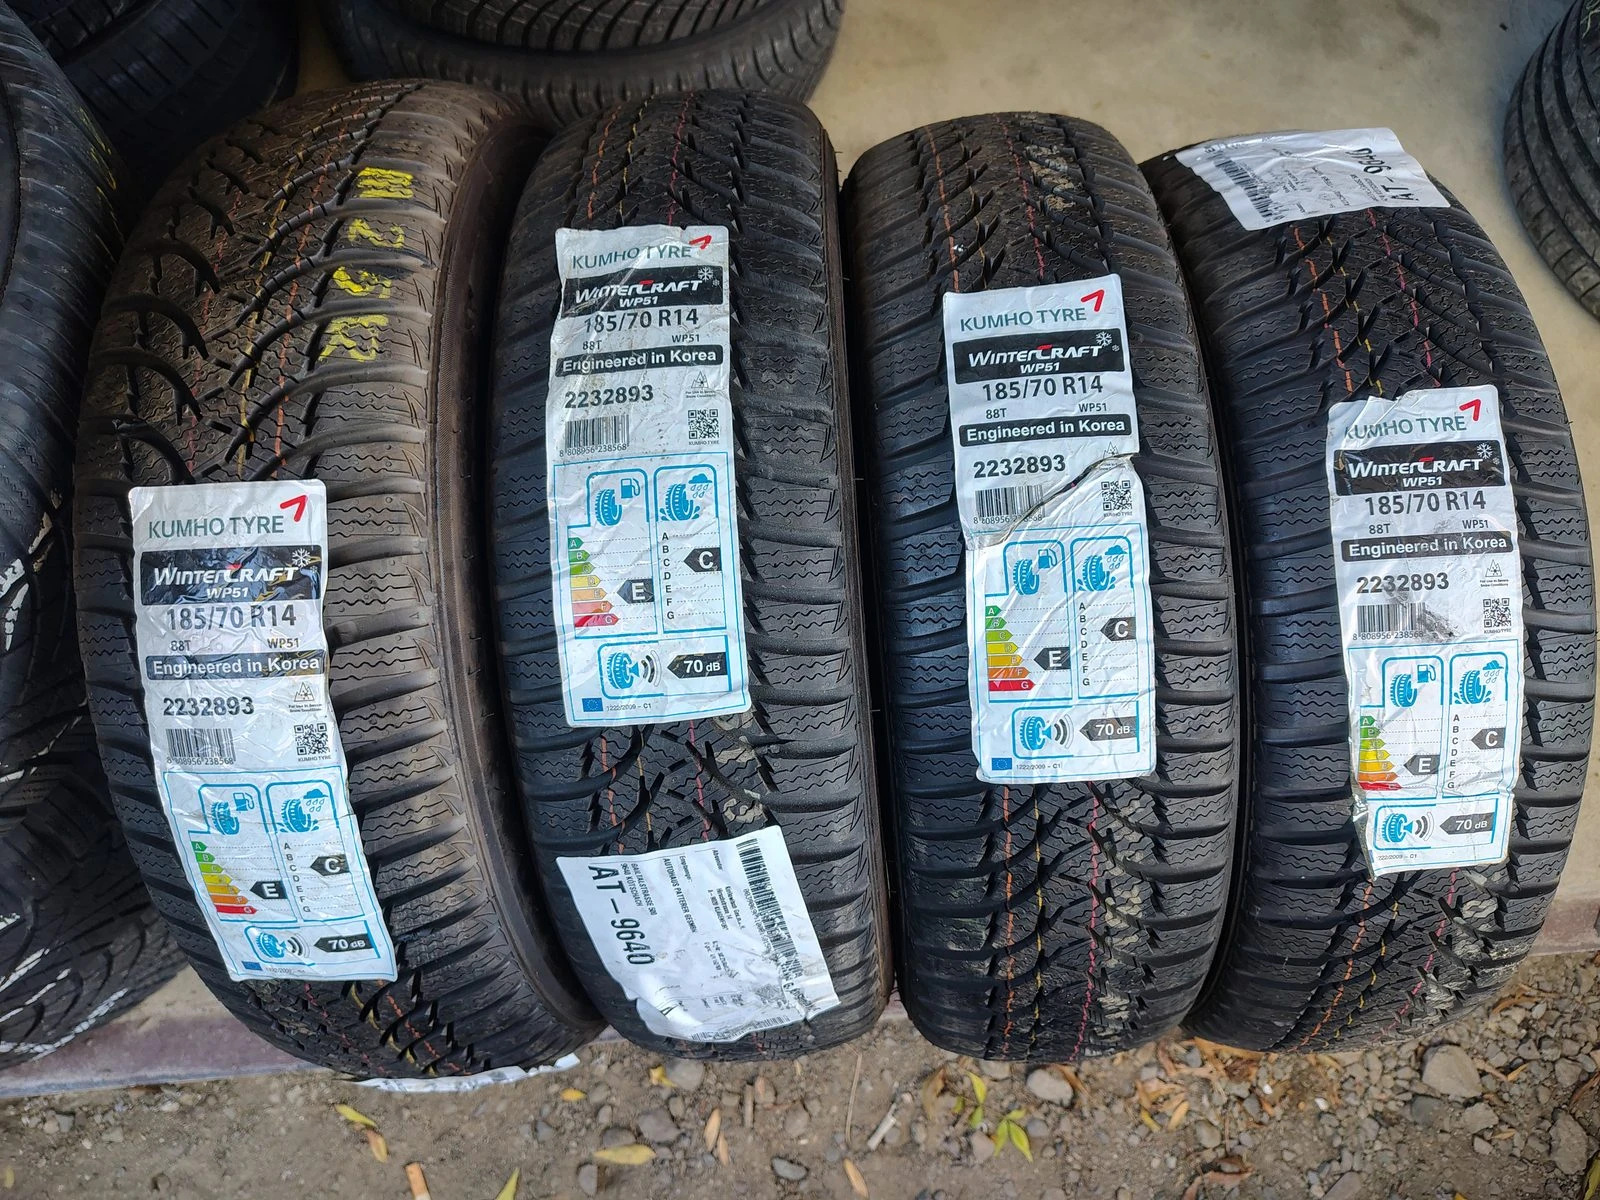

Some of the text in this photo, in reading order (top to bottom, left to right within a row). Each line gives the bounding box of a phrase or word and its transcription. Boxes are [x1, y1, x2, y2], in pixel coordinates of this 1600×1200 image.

[1381, 184, 1419, 202] AT
[572, 245, 691, 269] KUMHO TYRE
[619, 296, 658, 307] WP51
[584, 308, 699, 333] 185/70 R14
[960, 307, 1087, 332] KUMHO TYRE
[671, 334, 700, 343] WP51
[582, 340, 602, 351] 88T
[562, 350, 716, 373] Engineered in Korea
[1020, 362, 1060, 374] WP51
[982, 375, 1103, 401] 185/70 R14
[565, 384, 654, 409] 2232893
[985, 408, 1007, 419] 88T
[1078, 402, 1107, 412] WP51
[966, 419, 1125, 442] Engineered in Korea
[1344, 416, 1467, 440] KUMHO TYRE
[973, 454, 1066, 479] 2232893
[1402, 476, 1443, 488] WP51
[1365, 490, 1486, 516] 185/70 R14
[149, 515, 284, 539] KUMHO TYRE
[1369, 523, 1390, 534] 88T
[1462, 519, 1489, 529] WP51
[662, 532, 669, 540] A
[663, 545, 669, 553] B
[1349, 536, 1507, 558] Engineered in Korea
[663, 559, 670, 567] C
[699, 551, 714, 569] C
[664, 572, 671, 580] D
[666, 585, 671, 593] E
[1356, 572, 1449, 594] 2232893
[206, 587, 249, 599] WP51
[632, 583, 645, 600] E
[667, 598, 672, 606] F
[1079, 602, 1086, 610] A
[166, 604, 297, 631] 185/70 R14
[667, 611, 675, 620] G
[1080, 615, 1086, 623] B
[1115, 621, 1129, 638] C
[171, 640, 191, 652] 88T
[267, 638, 299, 649] WP51
[1081, 640, 1088, 648] D
[1050, 651, 1061, 667] E
[1082, 653, 1088, 661] E
[153, 656, 320, 677] Engineered in Korea
[683, 659, 721, 673] 70 dB
[1082, 678, 1090, 686] G
[163, 696, 255, 717] 2232893
[1453, 714, 1460, 722] A
[1095, 723, 1130, 737] 70 dB
[1452, 737, 1459, 745] C
[1485, 730, 1498, 745] C
[1451, 749, 1458, 757] D
[1418, 758, 1431, 773] E
[1455, 819, 1487, 831] 70 dB
[324, 858, 341, 873] C
[263, 883, 279, 898] E
[663, 858, 680, 887] AUTOHAUS
[672, 888, 689, 913] PATTERER
[588, 865, 627, 893] AT
[611, 918, 655, 965] 9640
[328, 939, 366, 949] 70 dB
